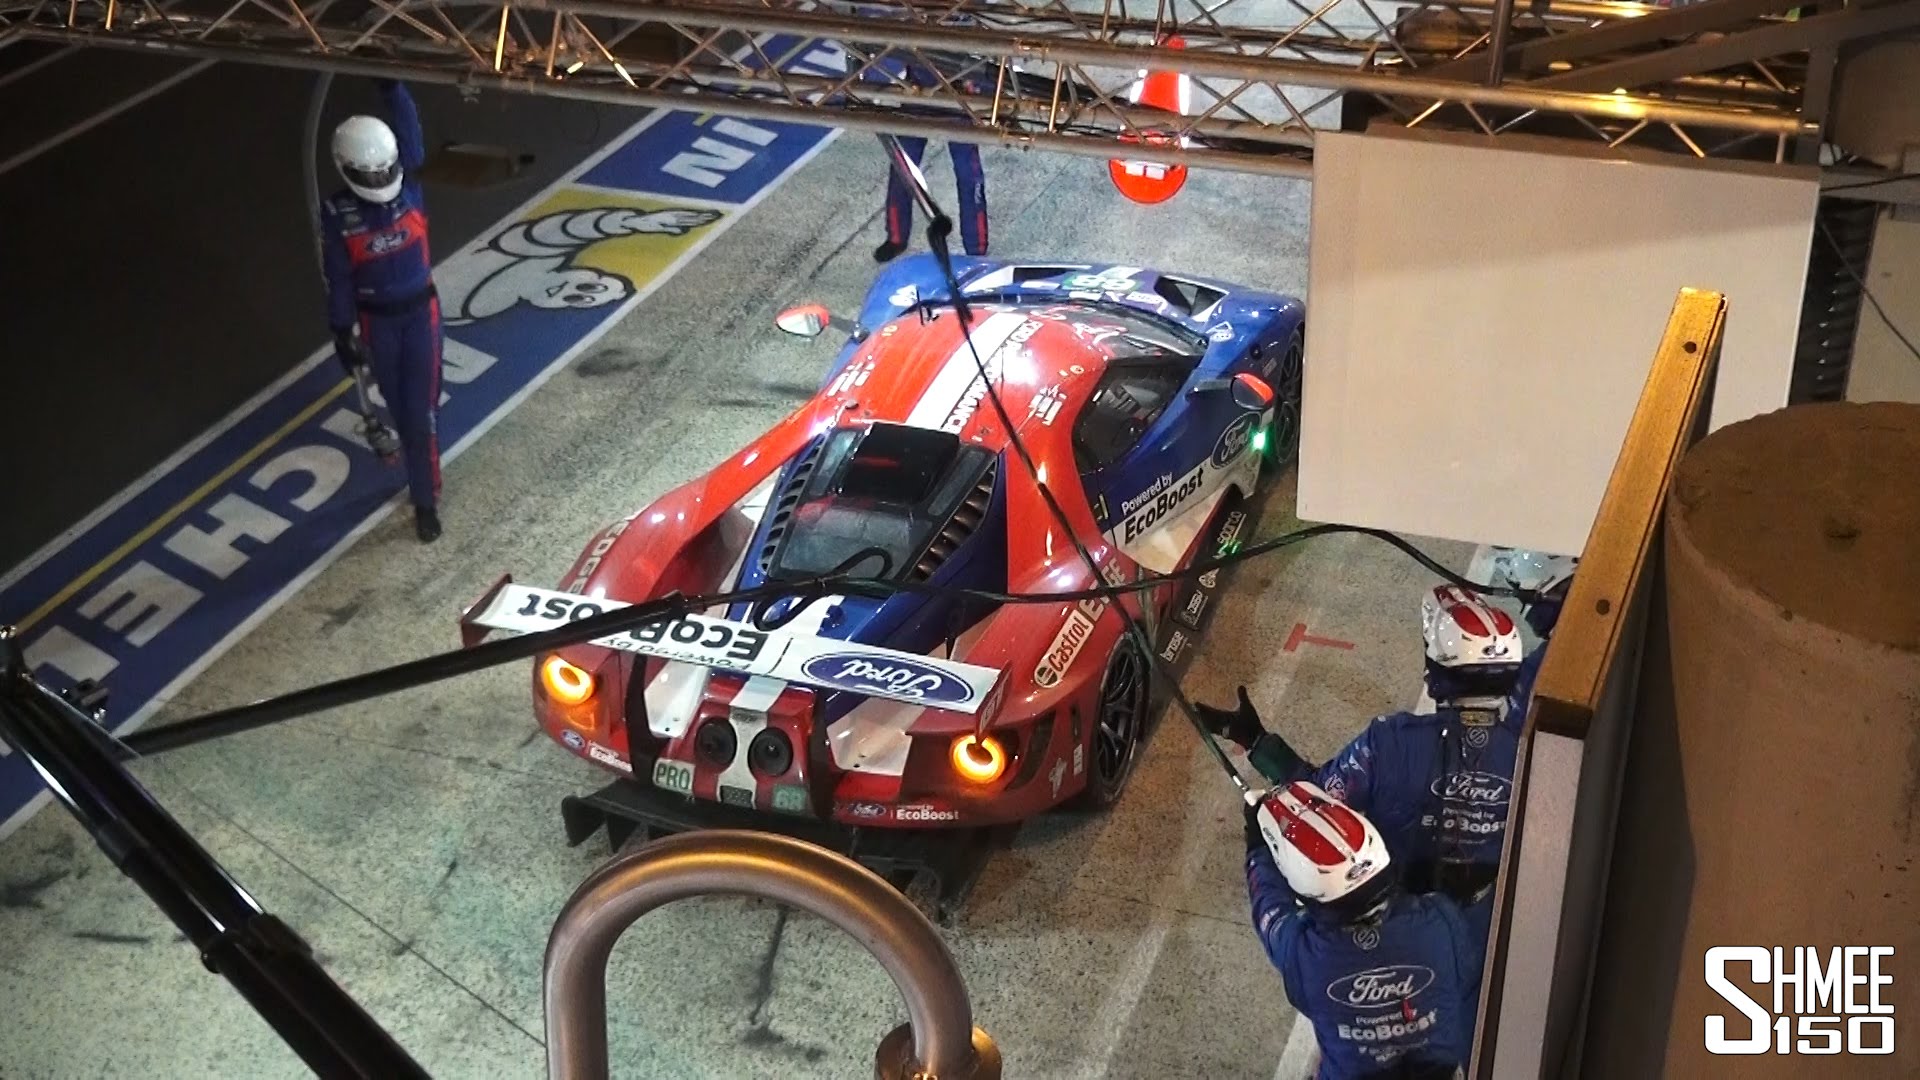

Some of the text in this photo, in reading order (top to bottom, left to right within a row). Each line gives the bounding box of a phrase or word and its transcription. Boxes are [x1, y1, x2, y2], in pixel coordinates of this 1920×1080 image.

[1220, 421, 1252, 462] Ford
[1121, 472, 1173, 516] Powered by
[1125, 467, 1204, 545] EcoBoost
[516, 592, 770, 663] EcoBost
[1048, 557, 1126, 673] Castrol EGE
[602, 636, 751, 671] Powered by
[832, 657, 943, 700] Ford
[655, 762, 691, 791] PRO
[1445, 774, 1504, 801] Ford
[895, 808, 960, 821] EcoBoost
[1348, 971, 1415, 1003] Ford
[1337, 1008, 1438, 1042] EcoBoost
